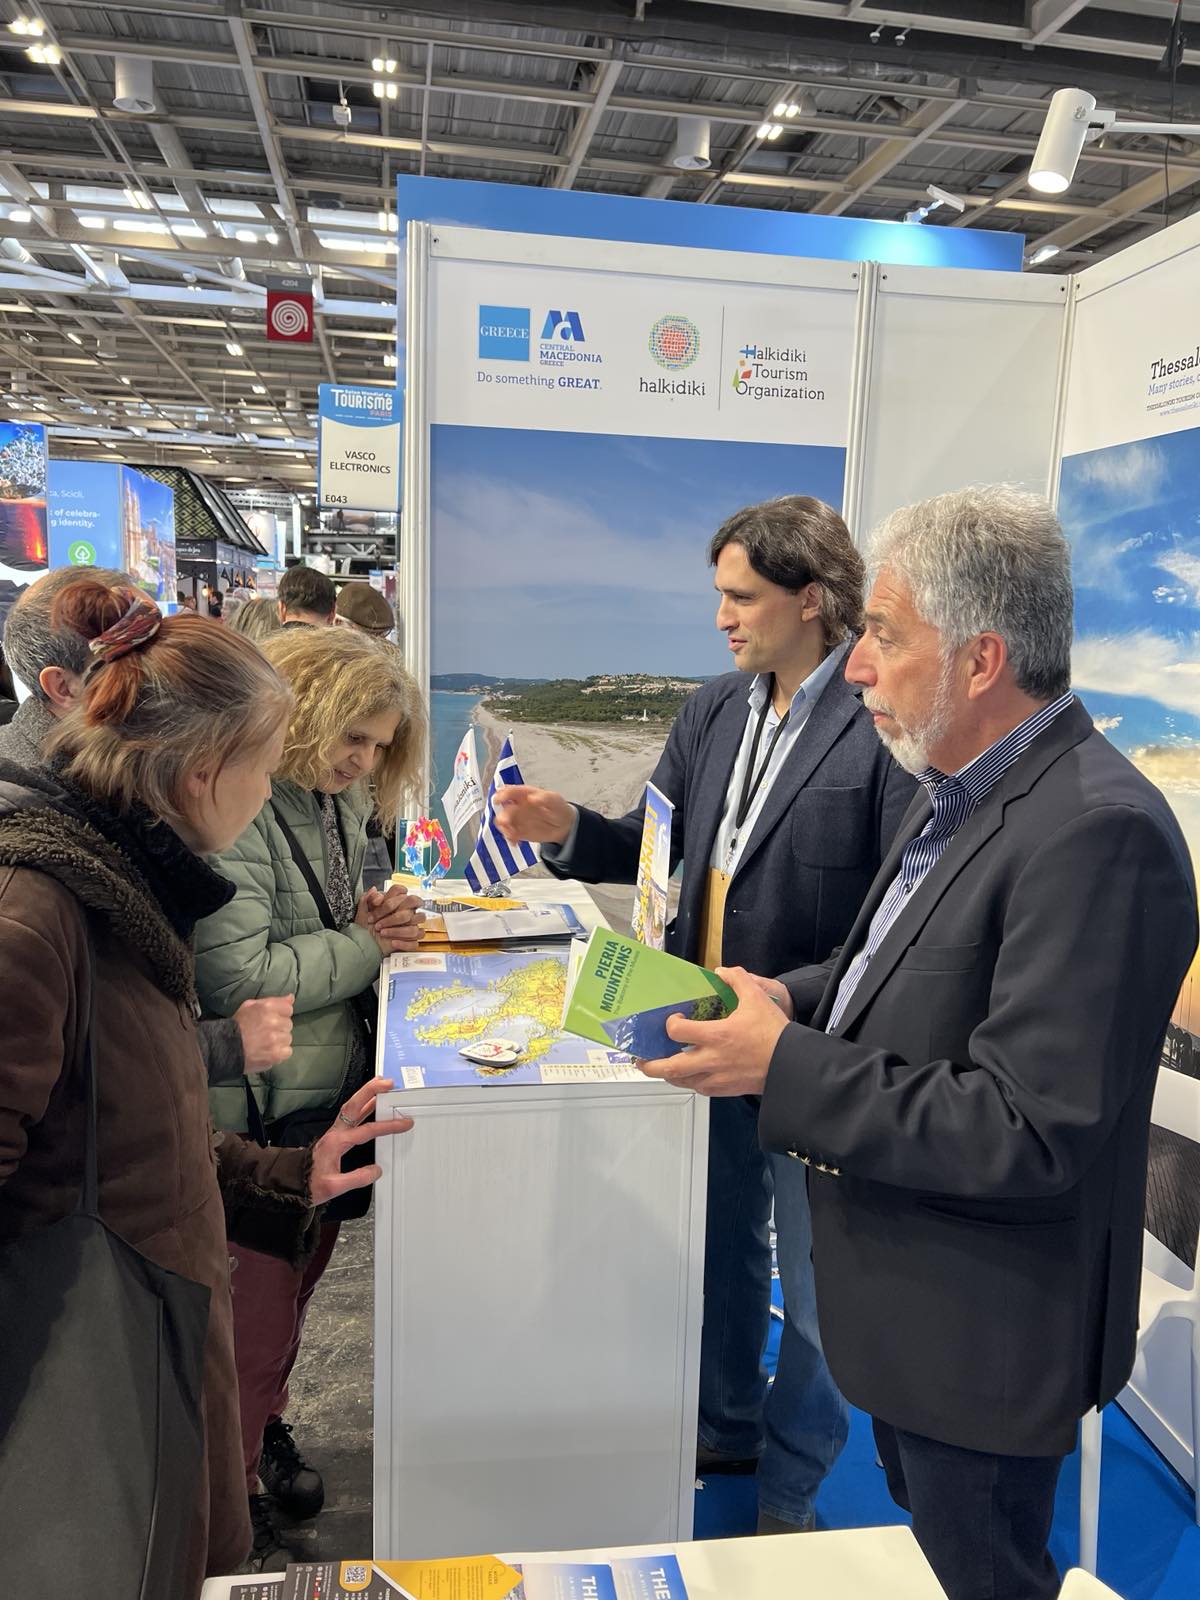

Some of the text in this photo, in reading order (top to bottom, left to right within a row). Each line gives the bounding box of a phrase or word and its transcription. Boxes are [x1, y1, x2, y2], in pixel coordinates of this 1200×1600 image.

[480, 325, 529, 339] GREECE
[540, 343, 575, 351] CENTRAL
[739, 344, 807, 363] Halkidiki
[540, 350, 602, 363] MACEDONIA
[477, 371, 492, 383] Do
[495, 374, 555, 389] something
[752, 363, 808, 381] Tourism
[639, 377, 706, 396] halkidiki
[735, 380, 825, 400] Organization
[1148, 383, 1168, 396] Many
[345, 450, 376, 461] VASCO
[330, 461, 391, 474] ELECTRONICS
[325, 494, 348, 504] E043
[594, 940, 619, 979] PIERIA
[600, 945, 632, 1013] MOUNTAINS
